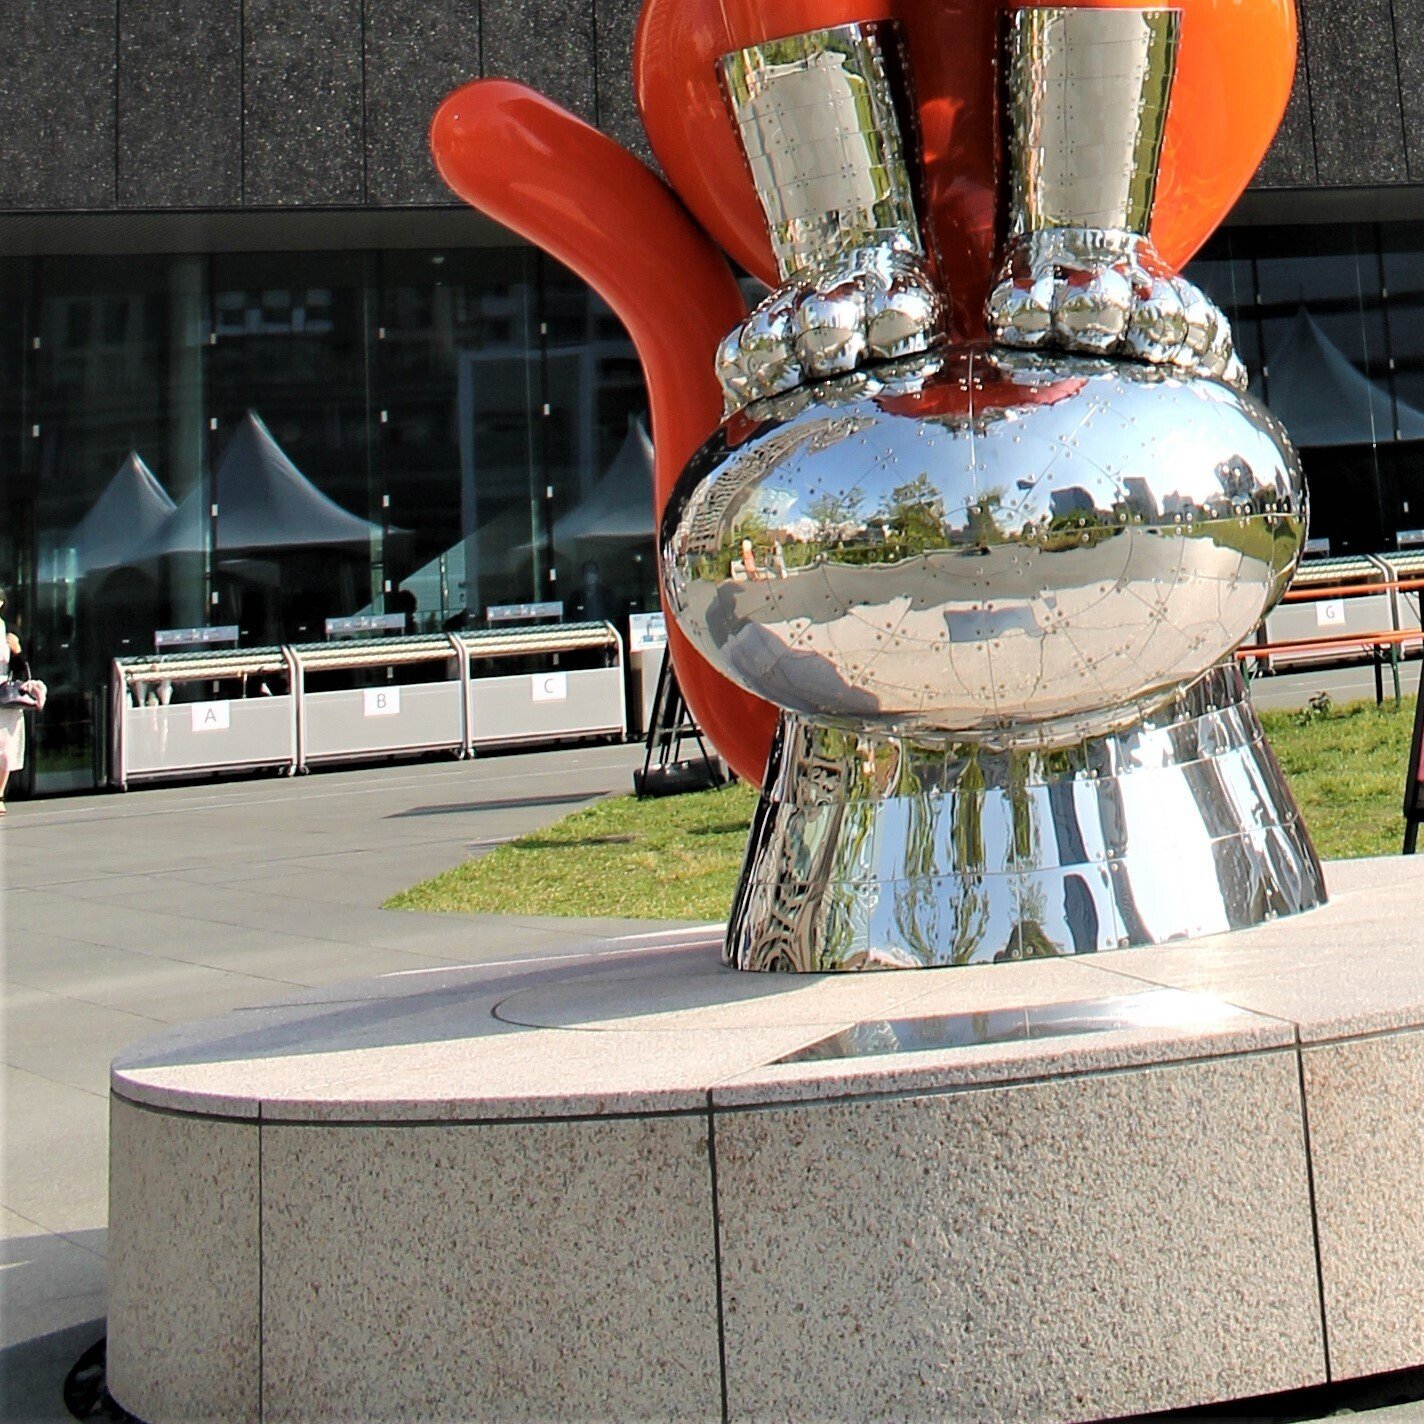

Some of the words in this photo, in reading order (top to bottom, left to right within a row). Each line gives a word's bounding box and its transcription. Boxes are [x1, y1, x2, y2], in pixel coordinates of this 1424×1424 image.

[1325, 605, 1335, 619] G
[544, 678, 554, 694] C
[377, 693, 387, 708] B
[204, 708, 217, 723] A
